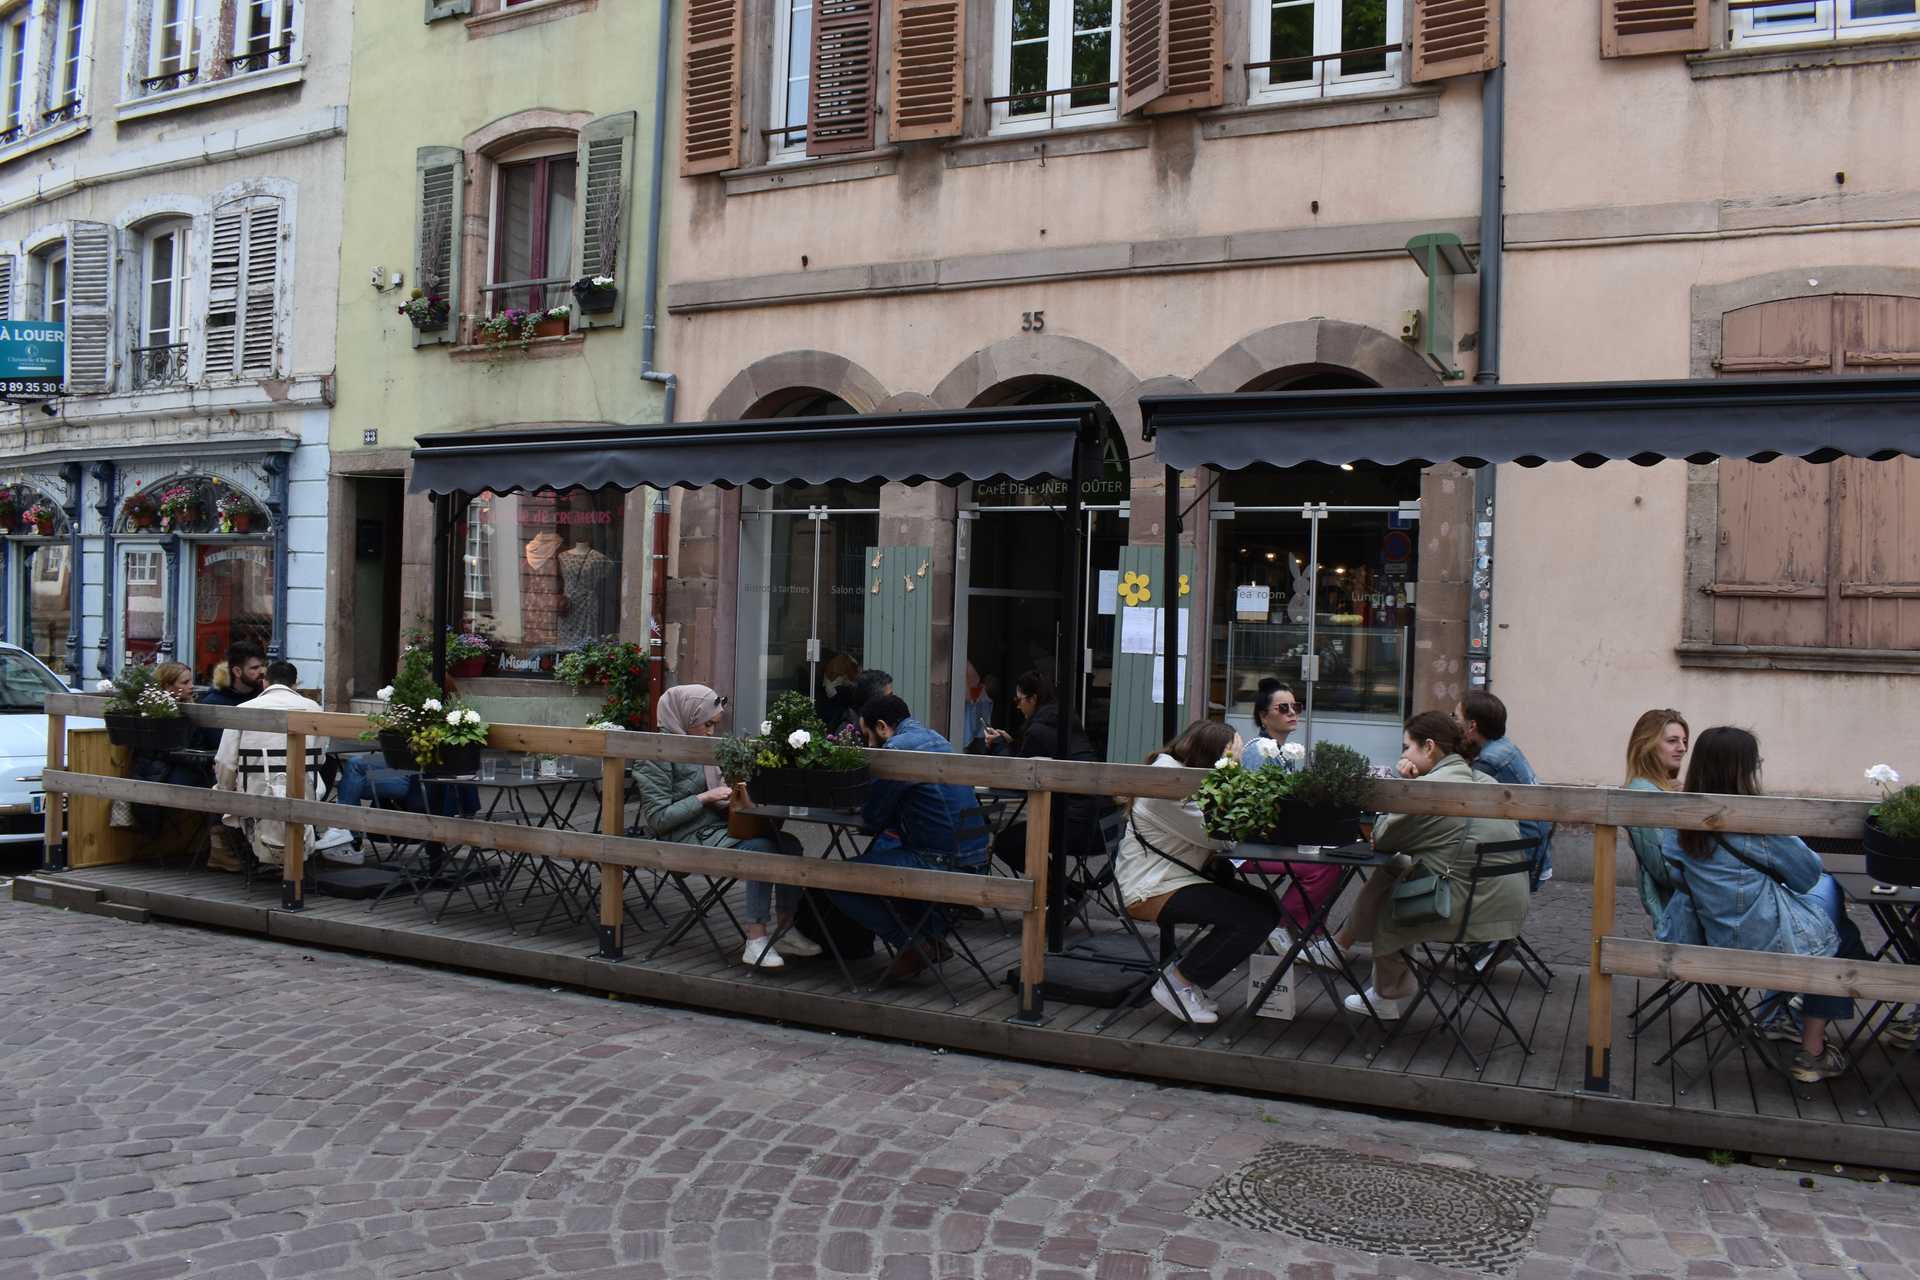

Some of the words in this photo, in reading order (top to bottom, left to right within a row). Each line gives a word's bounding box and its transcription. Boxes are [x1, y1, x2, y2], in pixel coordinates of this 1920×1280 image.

[1021, 310, 1045, 332] 35
[14, 329, 65, 342] LOUER
[9, 382, 24, 392] 89
[25, 382, 40, 392] 35
[42, 383, 57, 392] 30
[364, 431, 376, 442] 33
[1081, 479, 1122, 494] OÛTER
[831, 585, 854, 595] Salon
